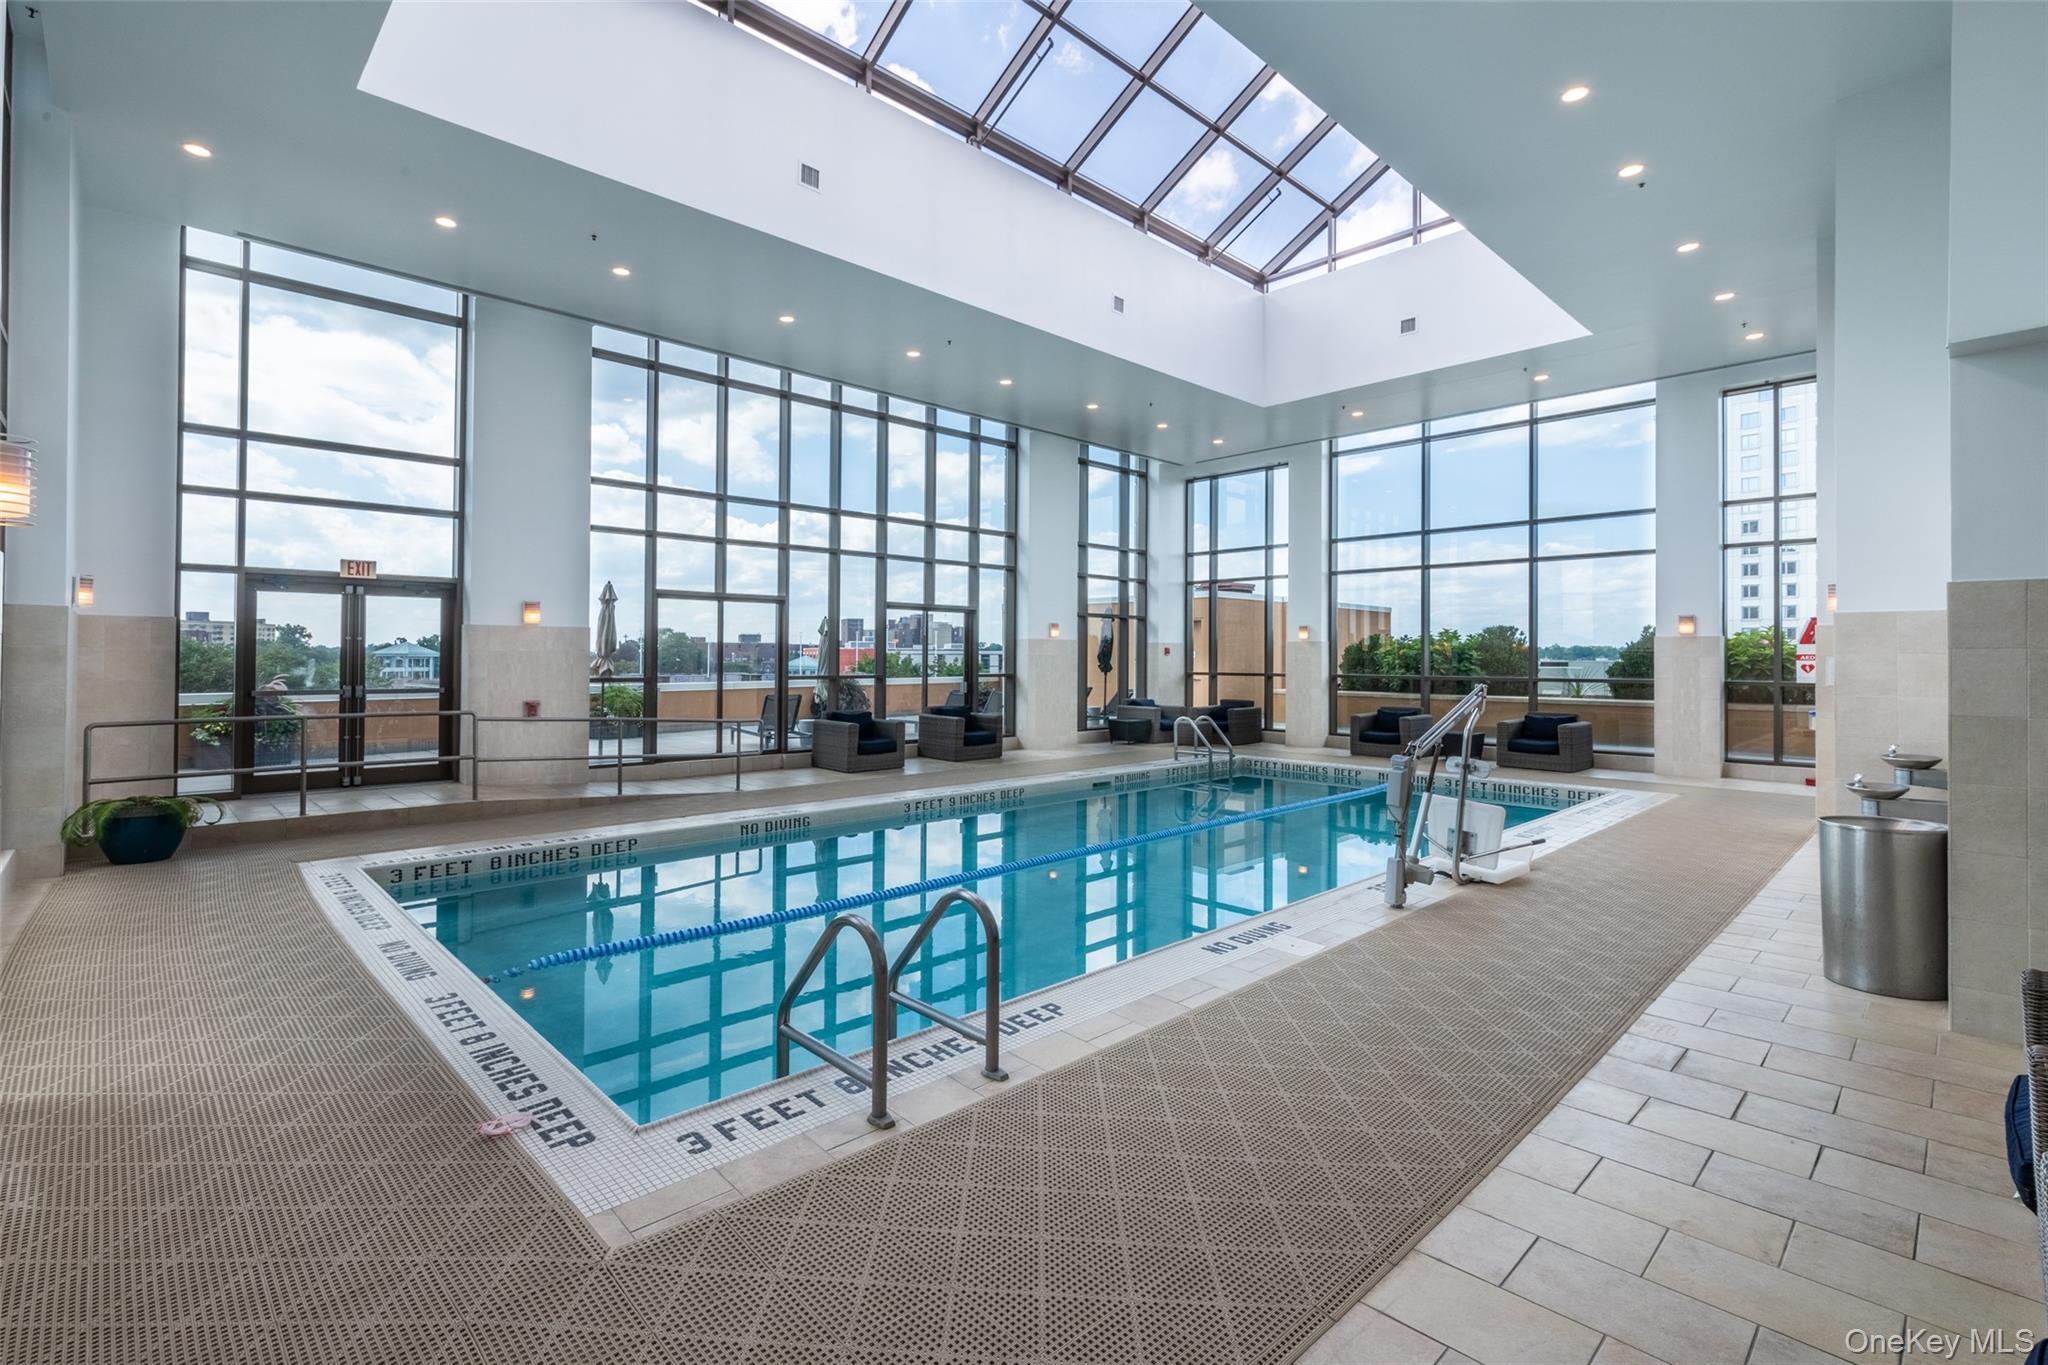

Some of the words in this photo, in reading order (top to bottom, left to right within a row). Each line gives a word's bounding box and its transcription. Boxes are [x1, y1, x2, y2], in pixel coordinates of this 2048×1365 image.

[347, 560, 372, 576] EXIT
[1254, 760, 1279, 770] FEET
[1292, 764, 1328, 775] INCHES
[1334, 768, 1362, 778] DEEP
[904, 803, 911, 813] 3
[915, 798, 944, 812] FEET
[948, 797, 956, 807] 9
[960, 792, 996, 805] INCHES
[1000, 788, 1025, 800] DEEP
[1444, 778, 1452, 788] 3
[1455, 780, 1488, 791] FET
[1493, 784, 1506, 793] 10
[1509, 785, 1559, 798] INCHES
[740, 823, 759, 836] NO
[765, 816, 811, 833] DIVING
[390, 868, 402, 884] 3
[414, 860, 472, 880] FEET
[490, 856, 502, 870] 8
[508, 846, 580, 869] INCHES
[592, 838, 638, 857] DEEP
[377, 940, 412, 954] NO
[1201, 941, 1238, 955] NO
[1230, 922, 1292, 945] DIVING
[386, 950, 438, 980] DIVING
[424, 992, 458, 1004] 3
[430, 1000, 487, 1033] FEET
[459, 1032, 497, 1046] 8
[469, 1042, 548, 1101] INCHES
[676, 1131, 713, 1155] 3
[712, 1088, 827, 1142] FEET
[834, 1076, 866, 1095] 8
[868, 1036, 976, 1081] NCHE
[998, 1002, 1064, 1037] DEEP
[518, 1097, 597, 1149] DEEP
